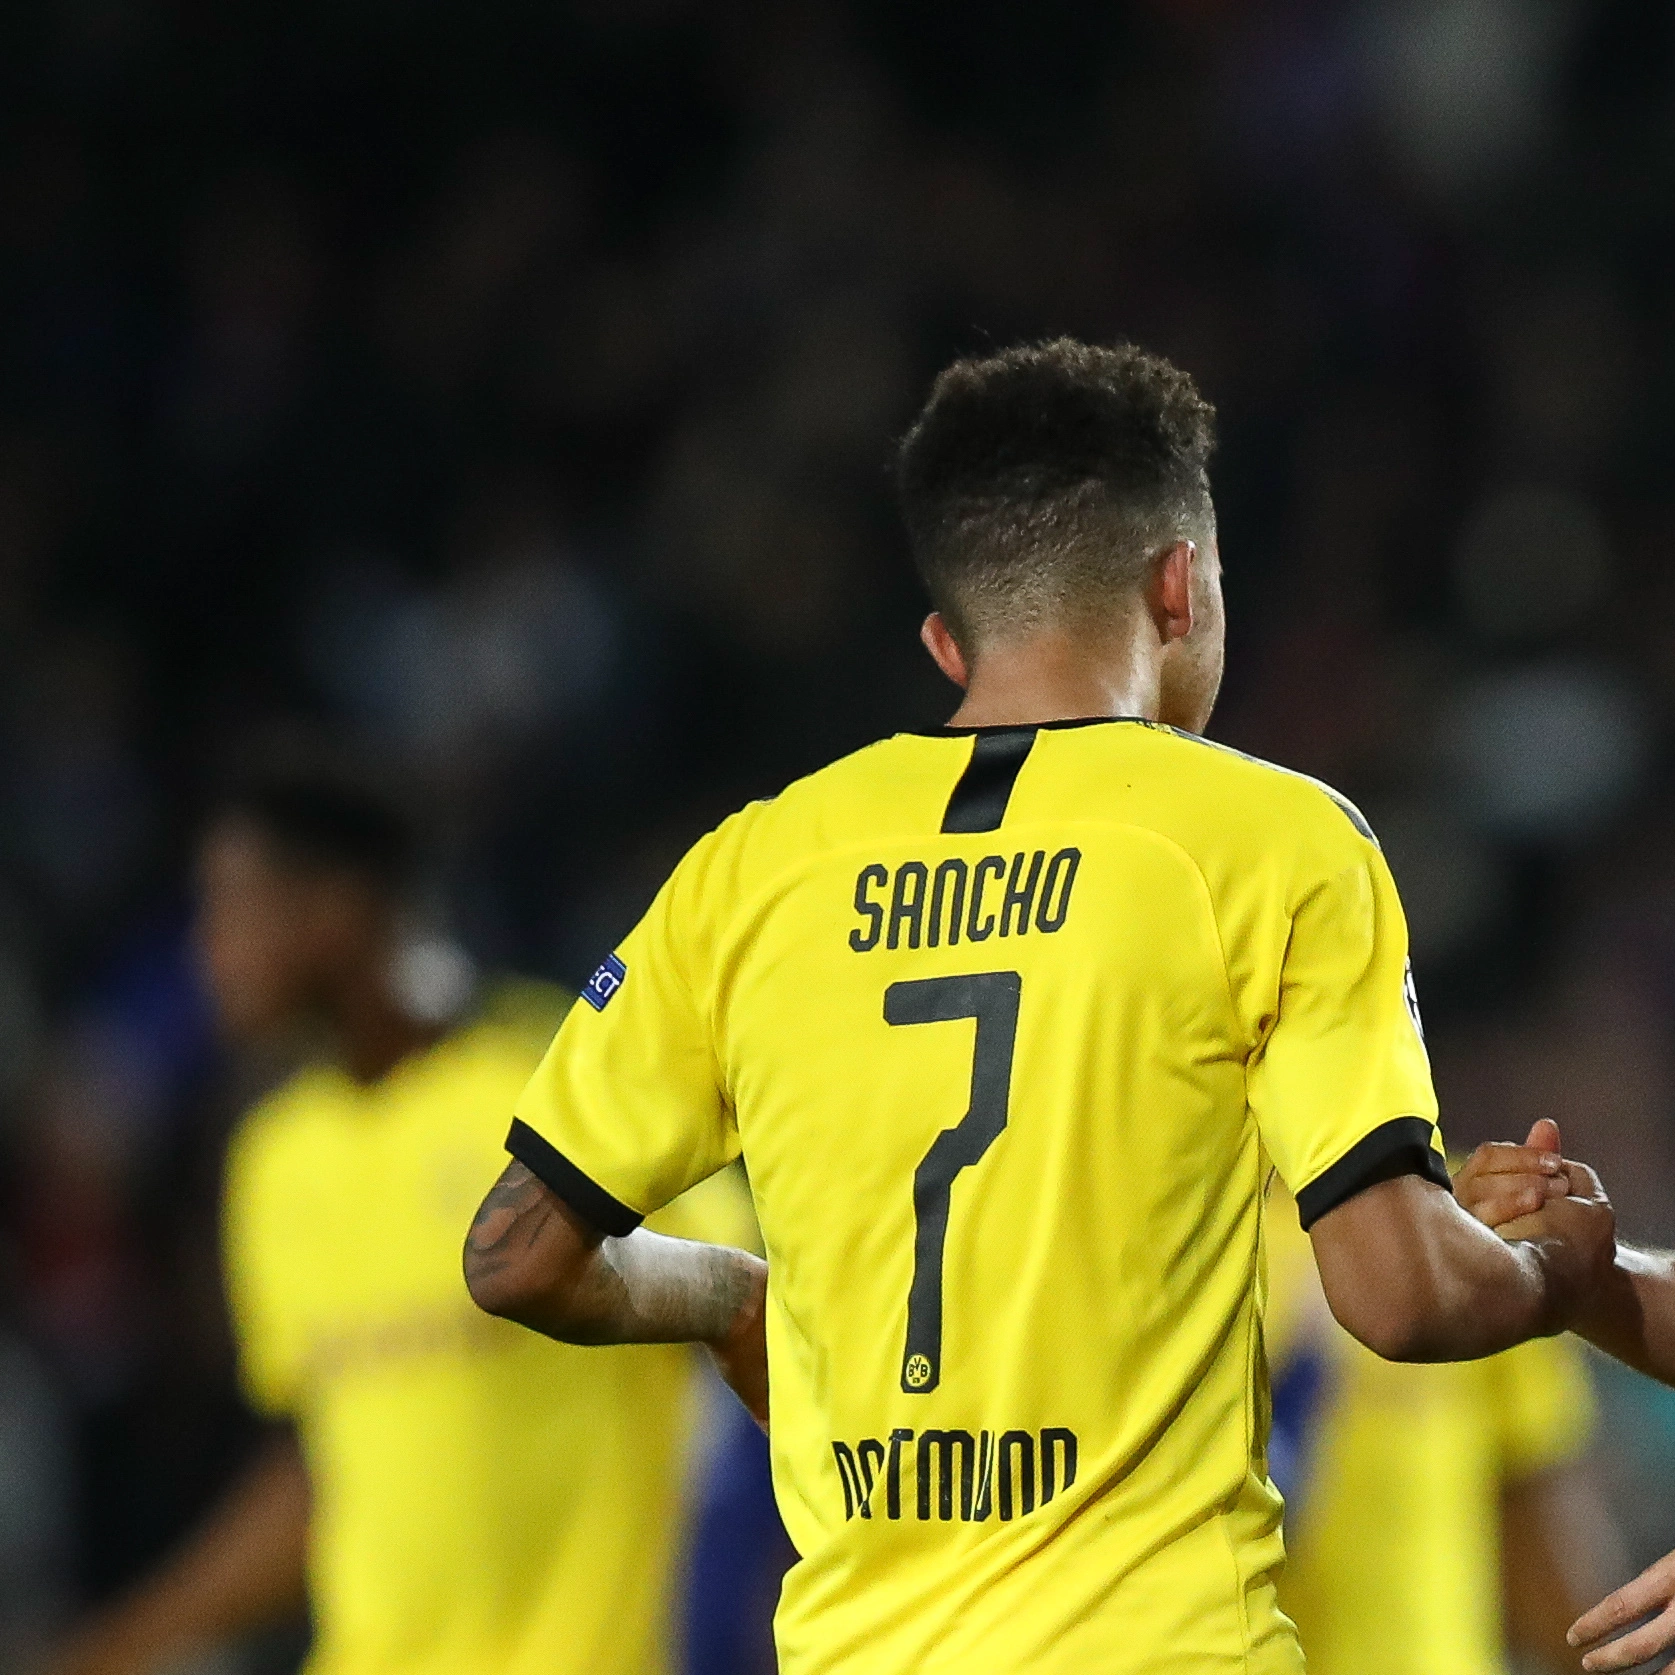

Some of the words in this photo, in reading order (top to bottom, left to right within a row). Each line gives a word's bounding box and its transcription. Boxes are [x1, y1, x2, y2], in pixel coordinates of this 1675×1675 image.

[848, 847, 1082, 953] SANCHO
[883, 970, 1021, 1393] 7
[909, 1357, 928, 1378] BVB
